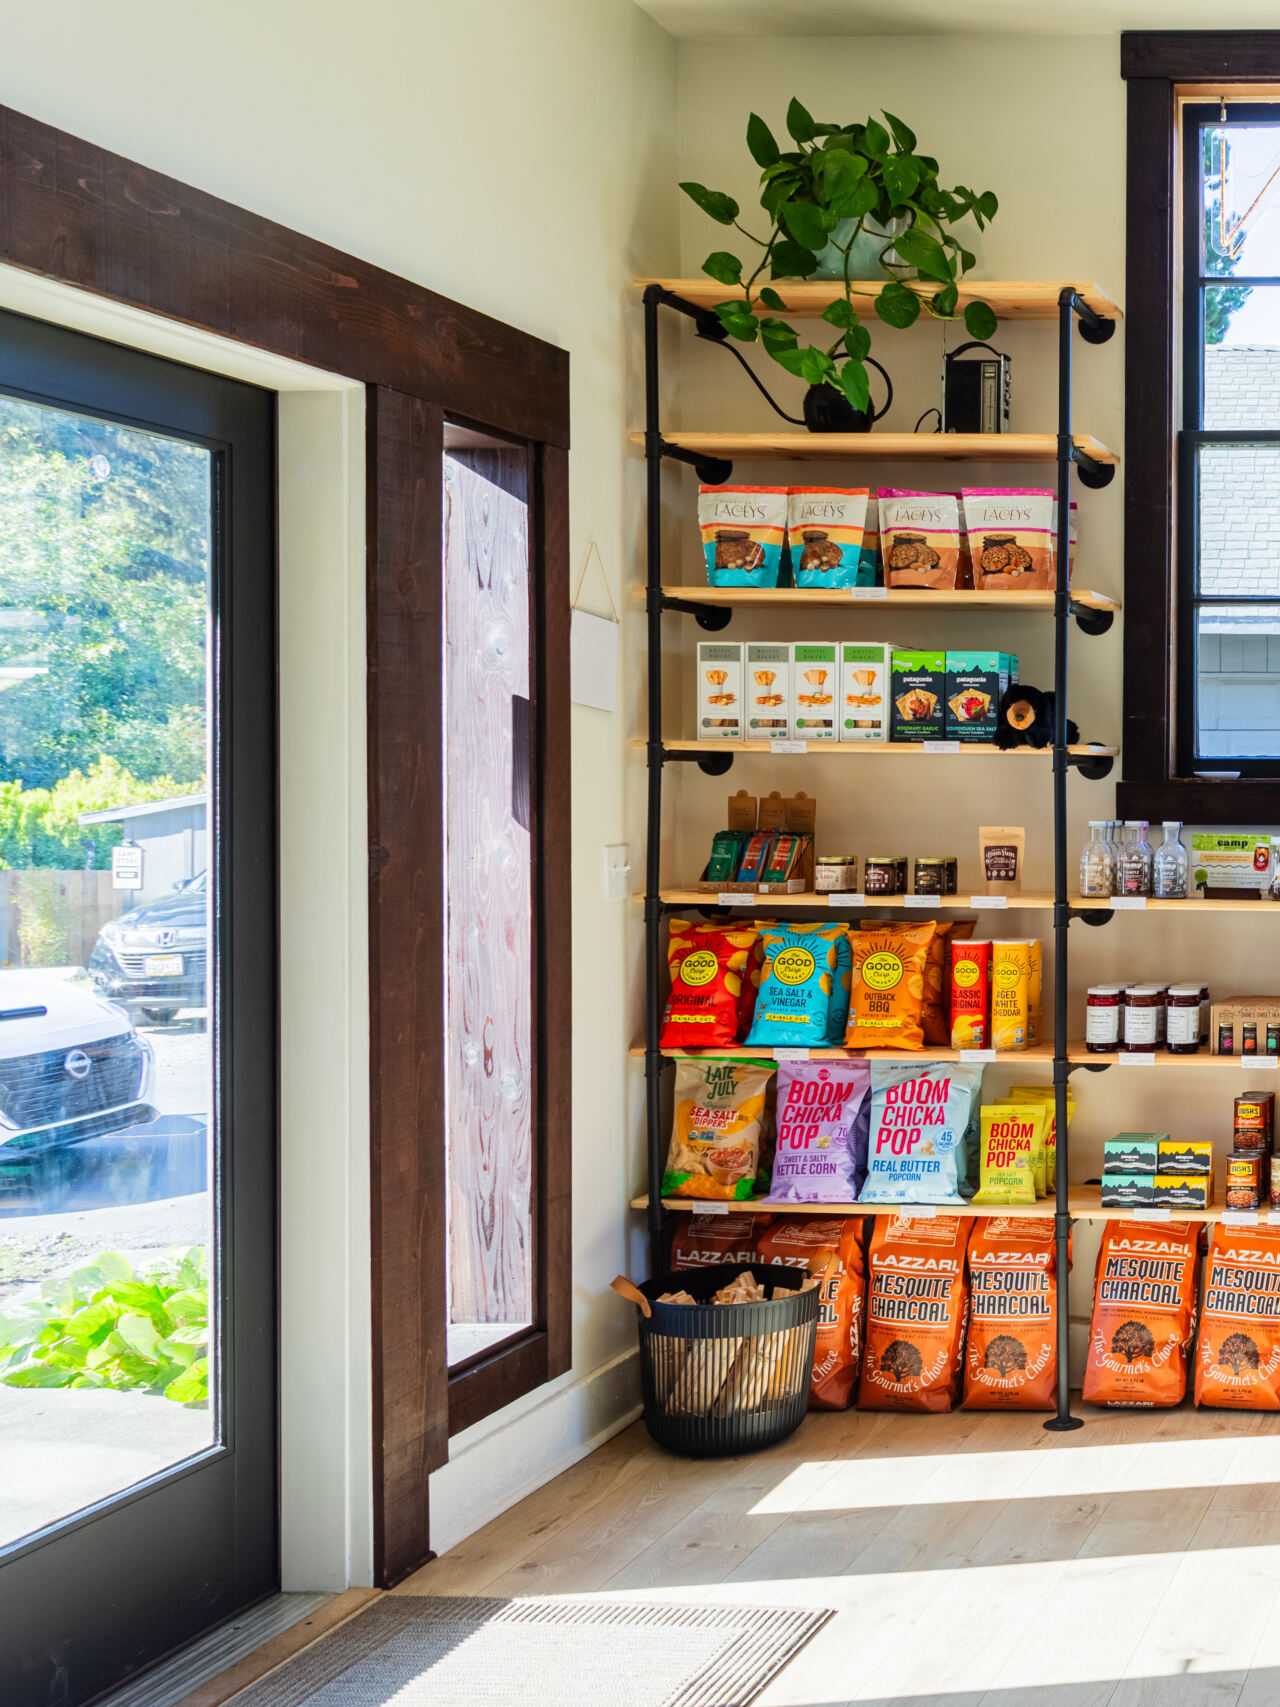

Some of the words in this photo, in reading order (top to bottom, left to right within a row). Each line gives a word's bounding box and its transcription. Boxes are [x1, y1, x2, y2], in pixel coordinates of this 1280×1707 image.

[1217, 839, 1248, 849] camp
[684, 959, 715, 968] GOOD
[777, 957, 812, 967] GOOD
[866, 962, 900, 972] GOOD
[780, 970, 806, 980] COMPANY
[868, 976, 895, 986] COMPANY
[769, 986, 783, 996] SEA
[785, 988, 805, 998] SALT
[807, 989, 813, 998] &
[864, 992, 896, 1002] OUTBACK
[997, 990, 1016, 999] AGED
[671, 994, 718, 1007] ORIGINAL
[772, 997, 807, 1007] VINEGAR
[868, 1001, 890, 1013] BBQ
[995, 1000, 1018, 1008] WHITE
[993, 1008, 1021, 1016] CHEDDAR
[706, 1065, 737, 1084] LATE
[706, 1081, 740, 1100] JULY
[787, 1080, 854, 1106] BOOM
[886, 1078, 950, 1105] BOOM
[690, 1106, 711, 1117] SEA
[713, 1109, 739, 1121] SALT
[782, 1104, 842, 1124] CHICKA
[881, 1105, 945, 1126] CHICKA
[1239, 1107, 1259, 1115] BUSH'S
[694, 1117, 728, 1129] DIPPERS
[990, 1122, 1034, 1138] BOOM
[778, 1124, 820, 1150] POP
[875, 1127, 922, 1155] POP
[941, 1131, 953, 1142] 45
[988, 1138, 1031, 1151] CHICKA
[784, 1155, 803, 1163] SWEET
[809, 1155, 828, 1163] SALTY
[872, 1159, 899, 1172] REAL
[900, 1160, 940, 1173] BUTTER
[986, 1151, 1016, 1168] POP
[777, 1164, 807, 1176] KETTLE
[809, 1163, 837, 1175] CORN
[888, 1173, 921, 1181] POPCORN
[1231, 1165, 1252, 1173] BUSH'S
[989, 1177, 1023, 1185] POPCORN
[1108, 1239, 1189, 1255] LAZZARI
[676, 1249, 756, 1264] LAZZARI
[872, 1253, 957, 1272] LAZZARI
[1105, 1258, 1185, 1282] MESQUITE
[873, 1274, 953, 1299] MESQUITE
[970, 1271, 1050, 1292] MESQUITE
[1100, 1281, 1181, 1305] CHARCOAL
[871, 1297, 950, 1322] CHARCOAL
[971, 1295, 1051, 1315] CHARCOAL
[1094, 1328, 1104, 1355] The
[969, 1343, 979, 1367] The
[1151, 1332, 1180, 1368] Choice
[1201, 1337, 1211, 1365] The
[811, 1350, 839, 1383] Choice
[1025, 1344, 1052, 1380] Choice
[1096, 1352, 1151, 1376] Gourmet's
[867, 1370, 920, 1393] Gourmet's
[920, 1350, 949, 1387] Choice
[971, 1367, 1025, 1389] Gourmet's
[1203, 1365, 1258, 1387] Gourmet's
